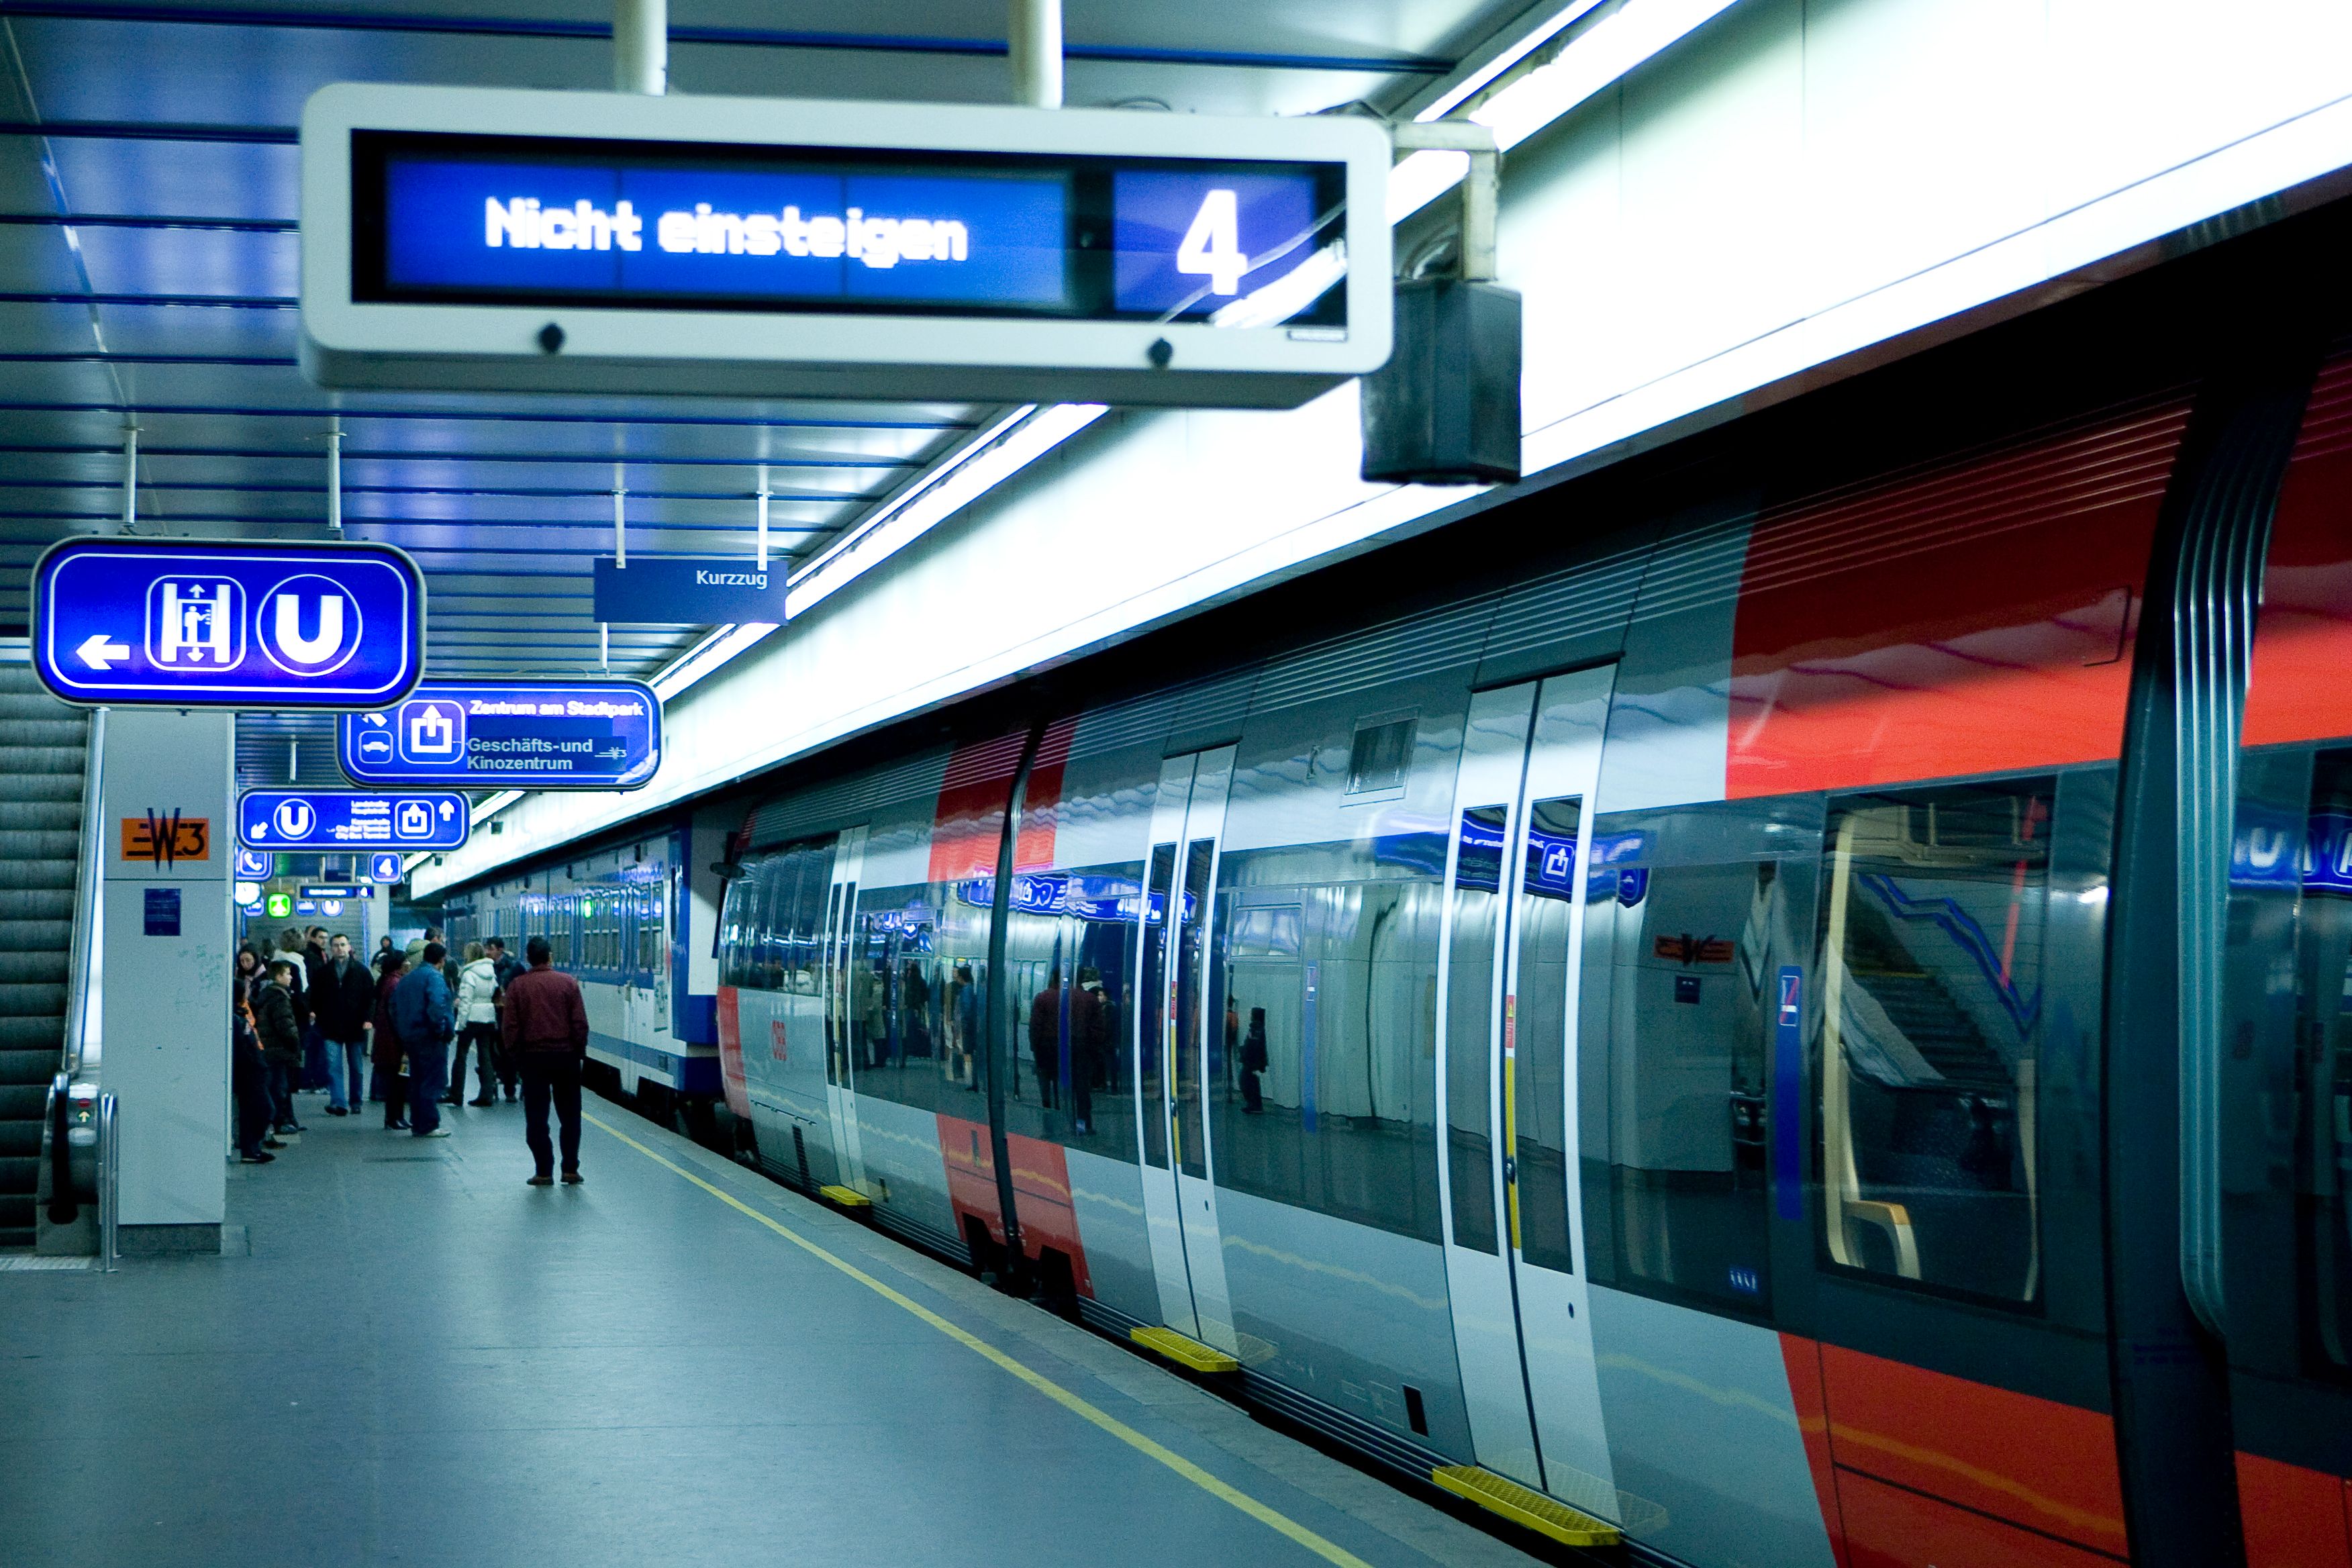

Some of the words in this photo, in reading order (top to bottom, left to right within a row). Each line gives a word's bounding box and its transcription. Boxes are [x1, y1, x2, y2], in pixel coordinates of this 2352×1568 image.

[485, 197, 642, 251] Nicht
[657, 203, 969, 268] einsteigen
[1177, 189, 1248, 295] 4
[697, 570, 768, 589] Kurzzug
[276, 594, 343, 664] U
[469, 699, 536, 715] Zentrum
[539, 704, 565, 716] am
[567, 701, 644, 718] Stadtpark
[467, 755, 573, 770] Kinozentrum
[281, 806, 309, 835] U
[379, 859, 393, 876] 4
